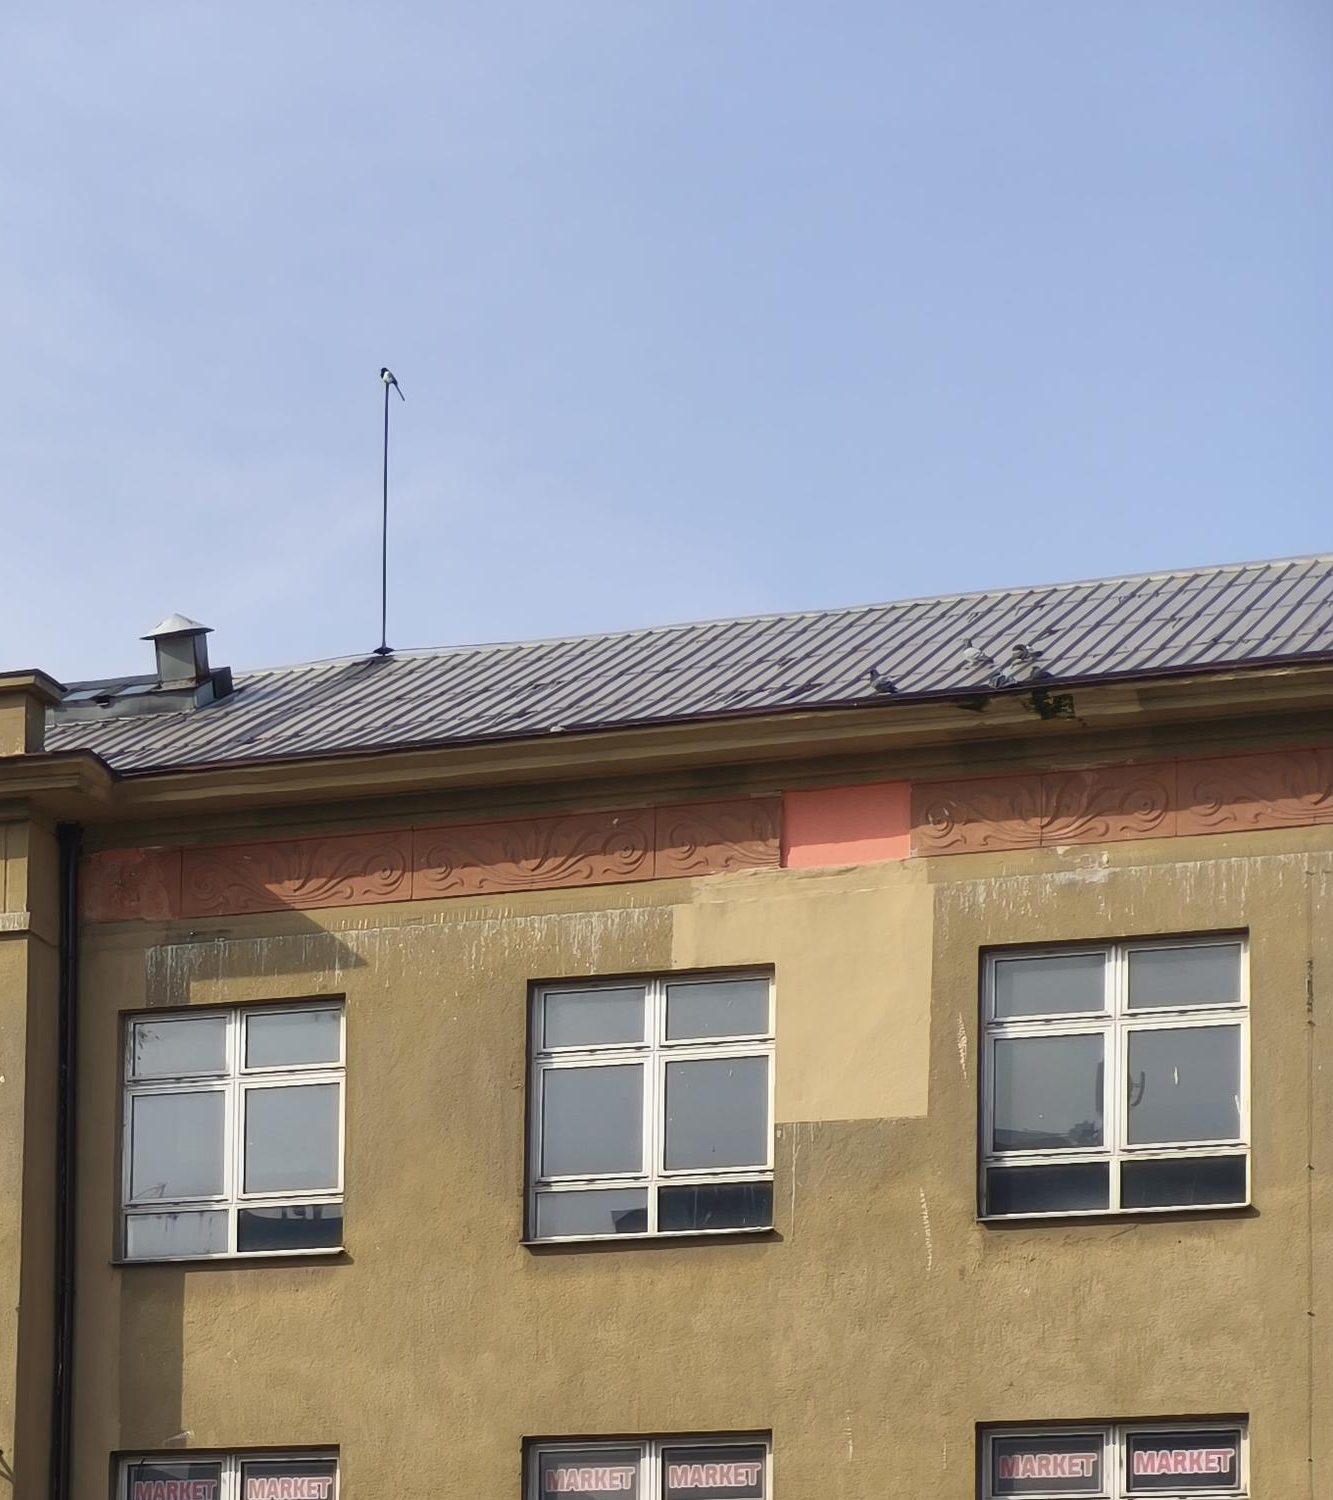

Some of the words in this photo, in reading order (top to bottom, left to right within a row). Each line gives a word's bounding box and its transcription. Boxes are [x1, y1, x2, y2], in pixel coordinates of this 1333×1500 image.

[999, 1453, 1097, 1479] MARKET
[1134, 1449, 1234, 1475] MARKET
[546, 1467, 635, 1492] MARKET
[669, 1463, 761, 1488] MARKET
[247, 1477, 332, 1500] MARKET
